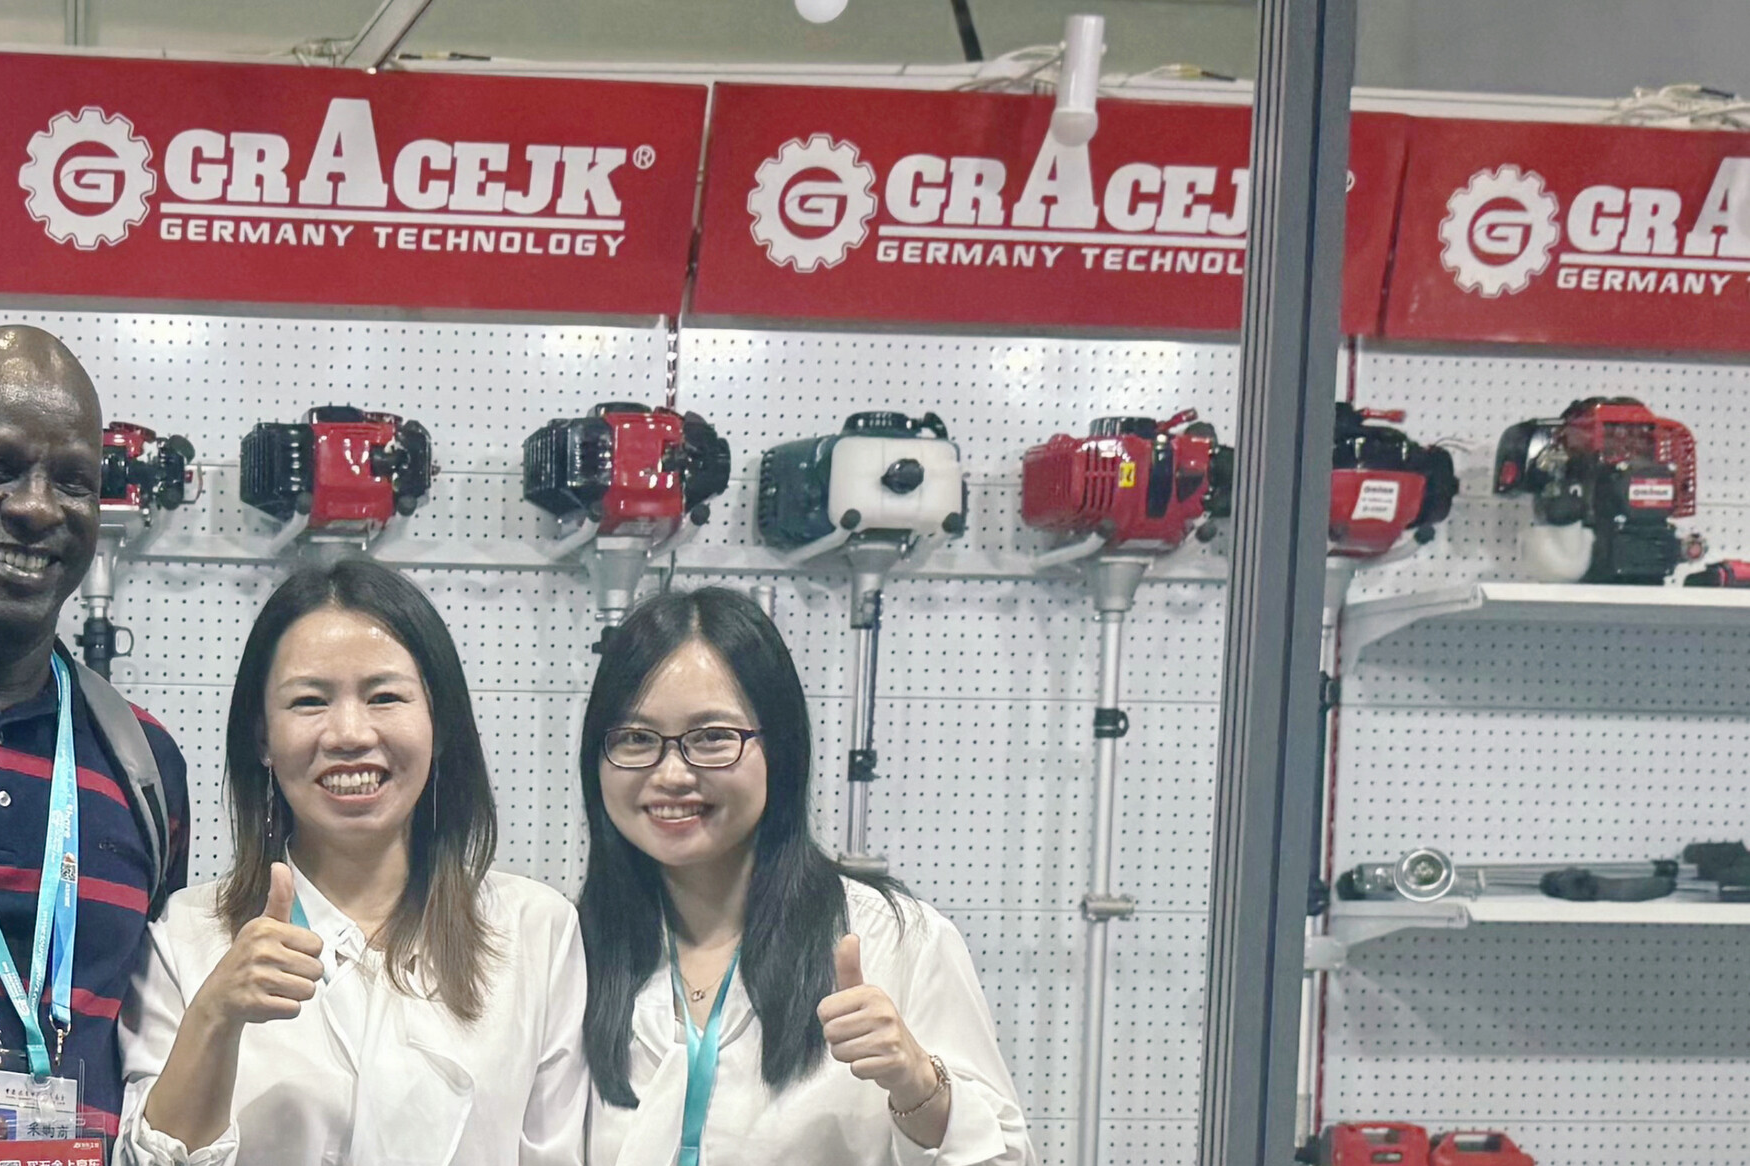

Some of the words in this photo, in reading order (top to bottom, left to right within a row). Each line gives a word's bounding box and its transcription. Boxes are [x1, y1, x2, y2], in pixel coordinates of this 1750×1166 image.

[885, 126, 1248, 235] GRACEJ
[160, 219, 354, 248] GERMANY
[374, 226, 626, 257] TECHNOLOGY
[876, 242, 1063, 268] GERMANY
[1081, 247, 1244, 275] TECHNOL
[1557, 268, 1733, 295] GERMANY
